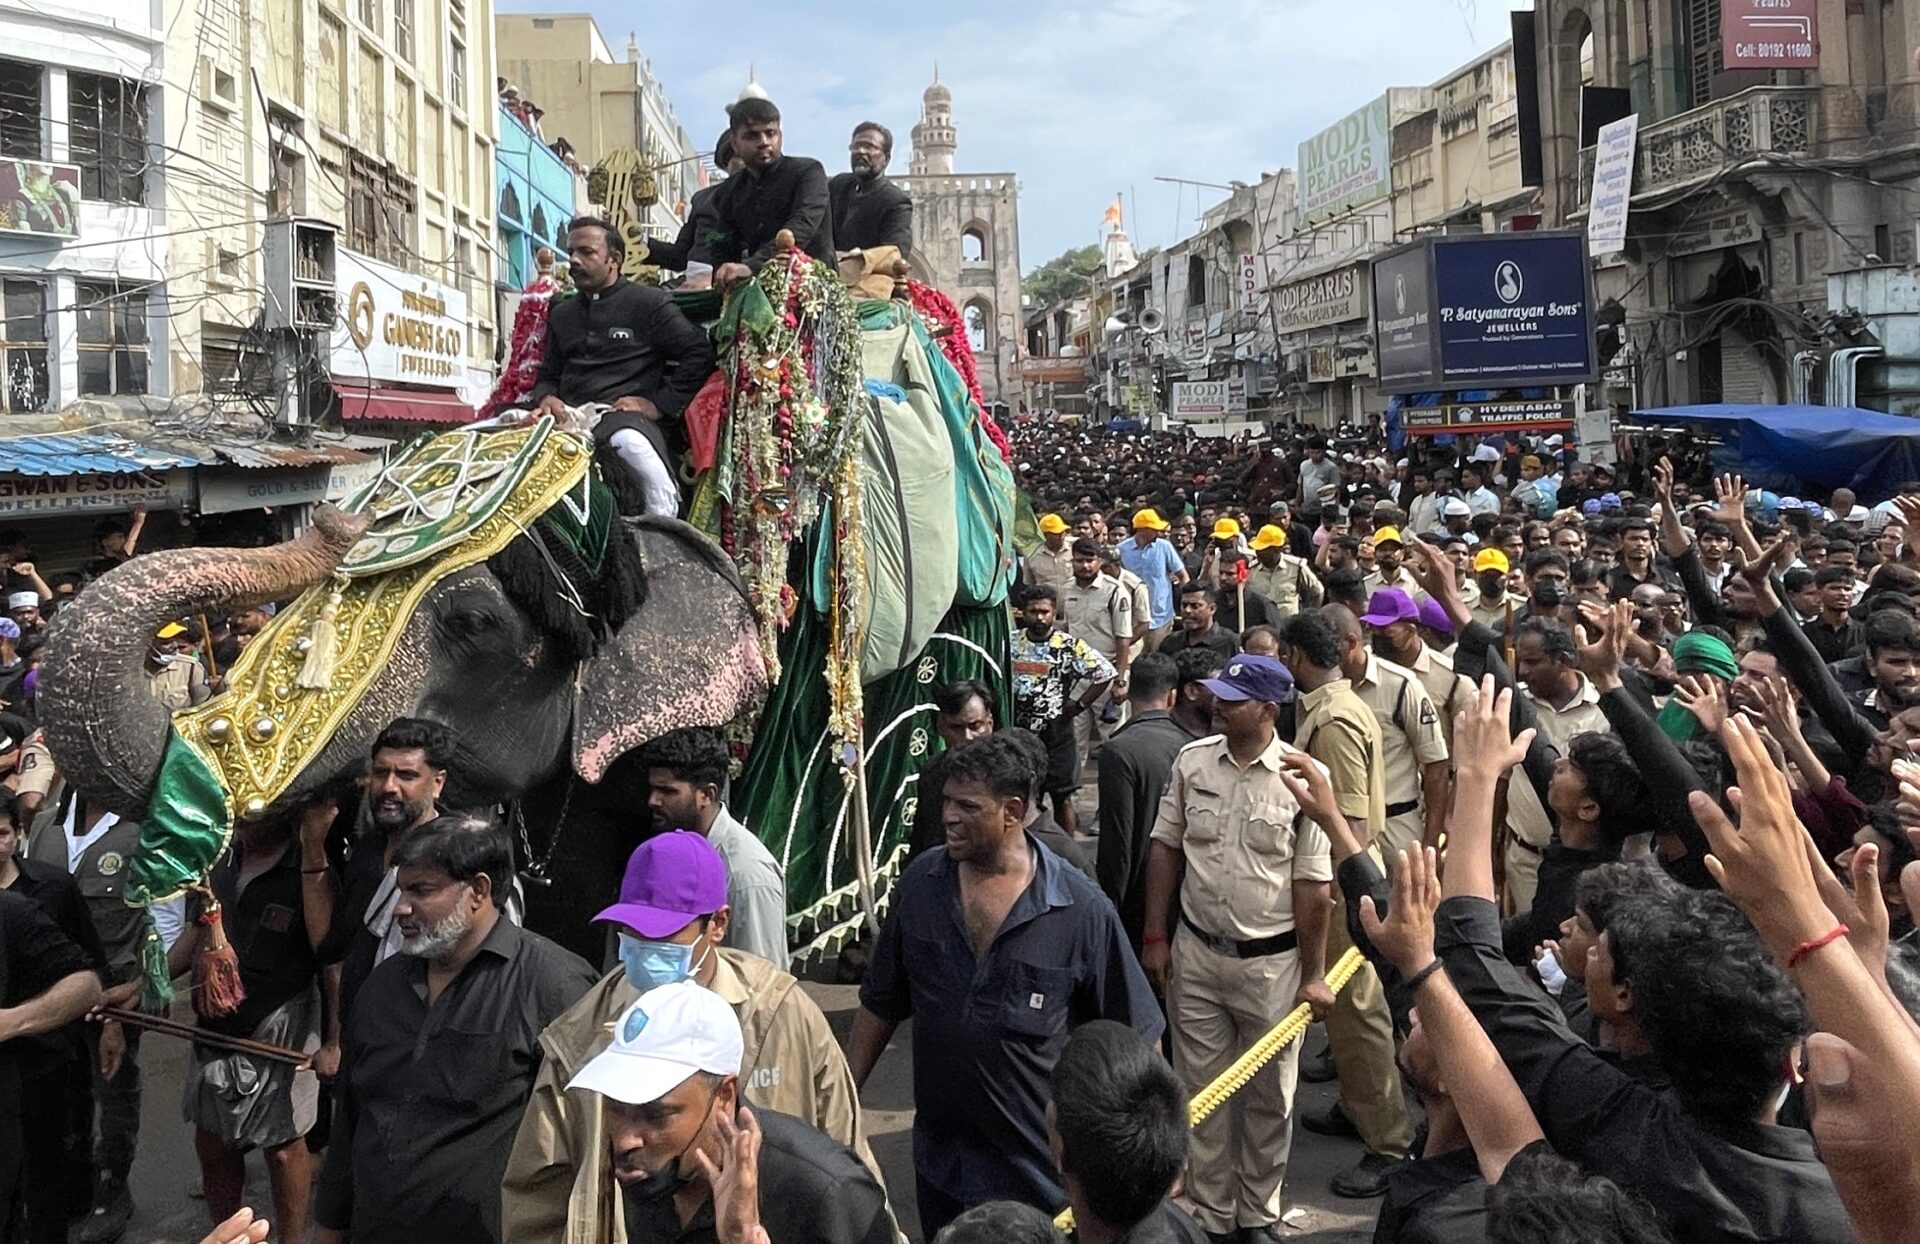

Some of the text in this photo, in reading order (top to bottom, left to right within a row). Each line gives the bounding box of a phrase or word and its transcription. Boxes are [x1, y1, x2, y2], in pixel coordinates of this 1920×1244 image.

[1307, 107, 1371, 173] MODI
[1307, 146, 1372, 197] PEARLS
[1243, 255, 1255, 303] MODI
[1273, 271, 1353, 313] MODI PEARLS
[1440, 307, 1454, 322] P.
[1456, 305, 1544, 323] Satyanarayan
[383, 312, 461, 357] GANESH & CO
[1486, 322, 1538, 333] JEWELLERS
[1178, 383, 1224, 396] MODI
[1480, 403, 1562, 413] HYDERABAD
[1480, 412, 1562, 423] TRAFFIC POLICE
[95, 471, 168, 492] SONS
[247, 483, 284, 498] GOLD
[289, 483, 297, 493] &
[303, 476, 347, 492] SILVER
